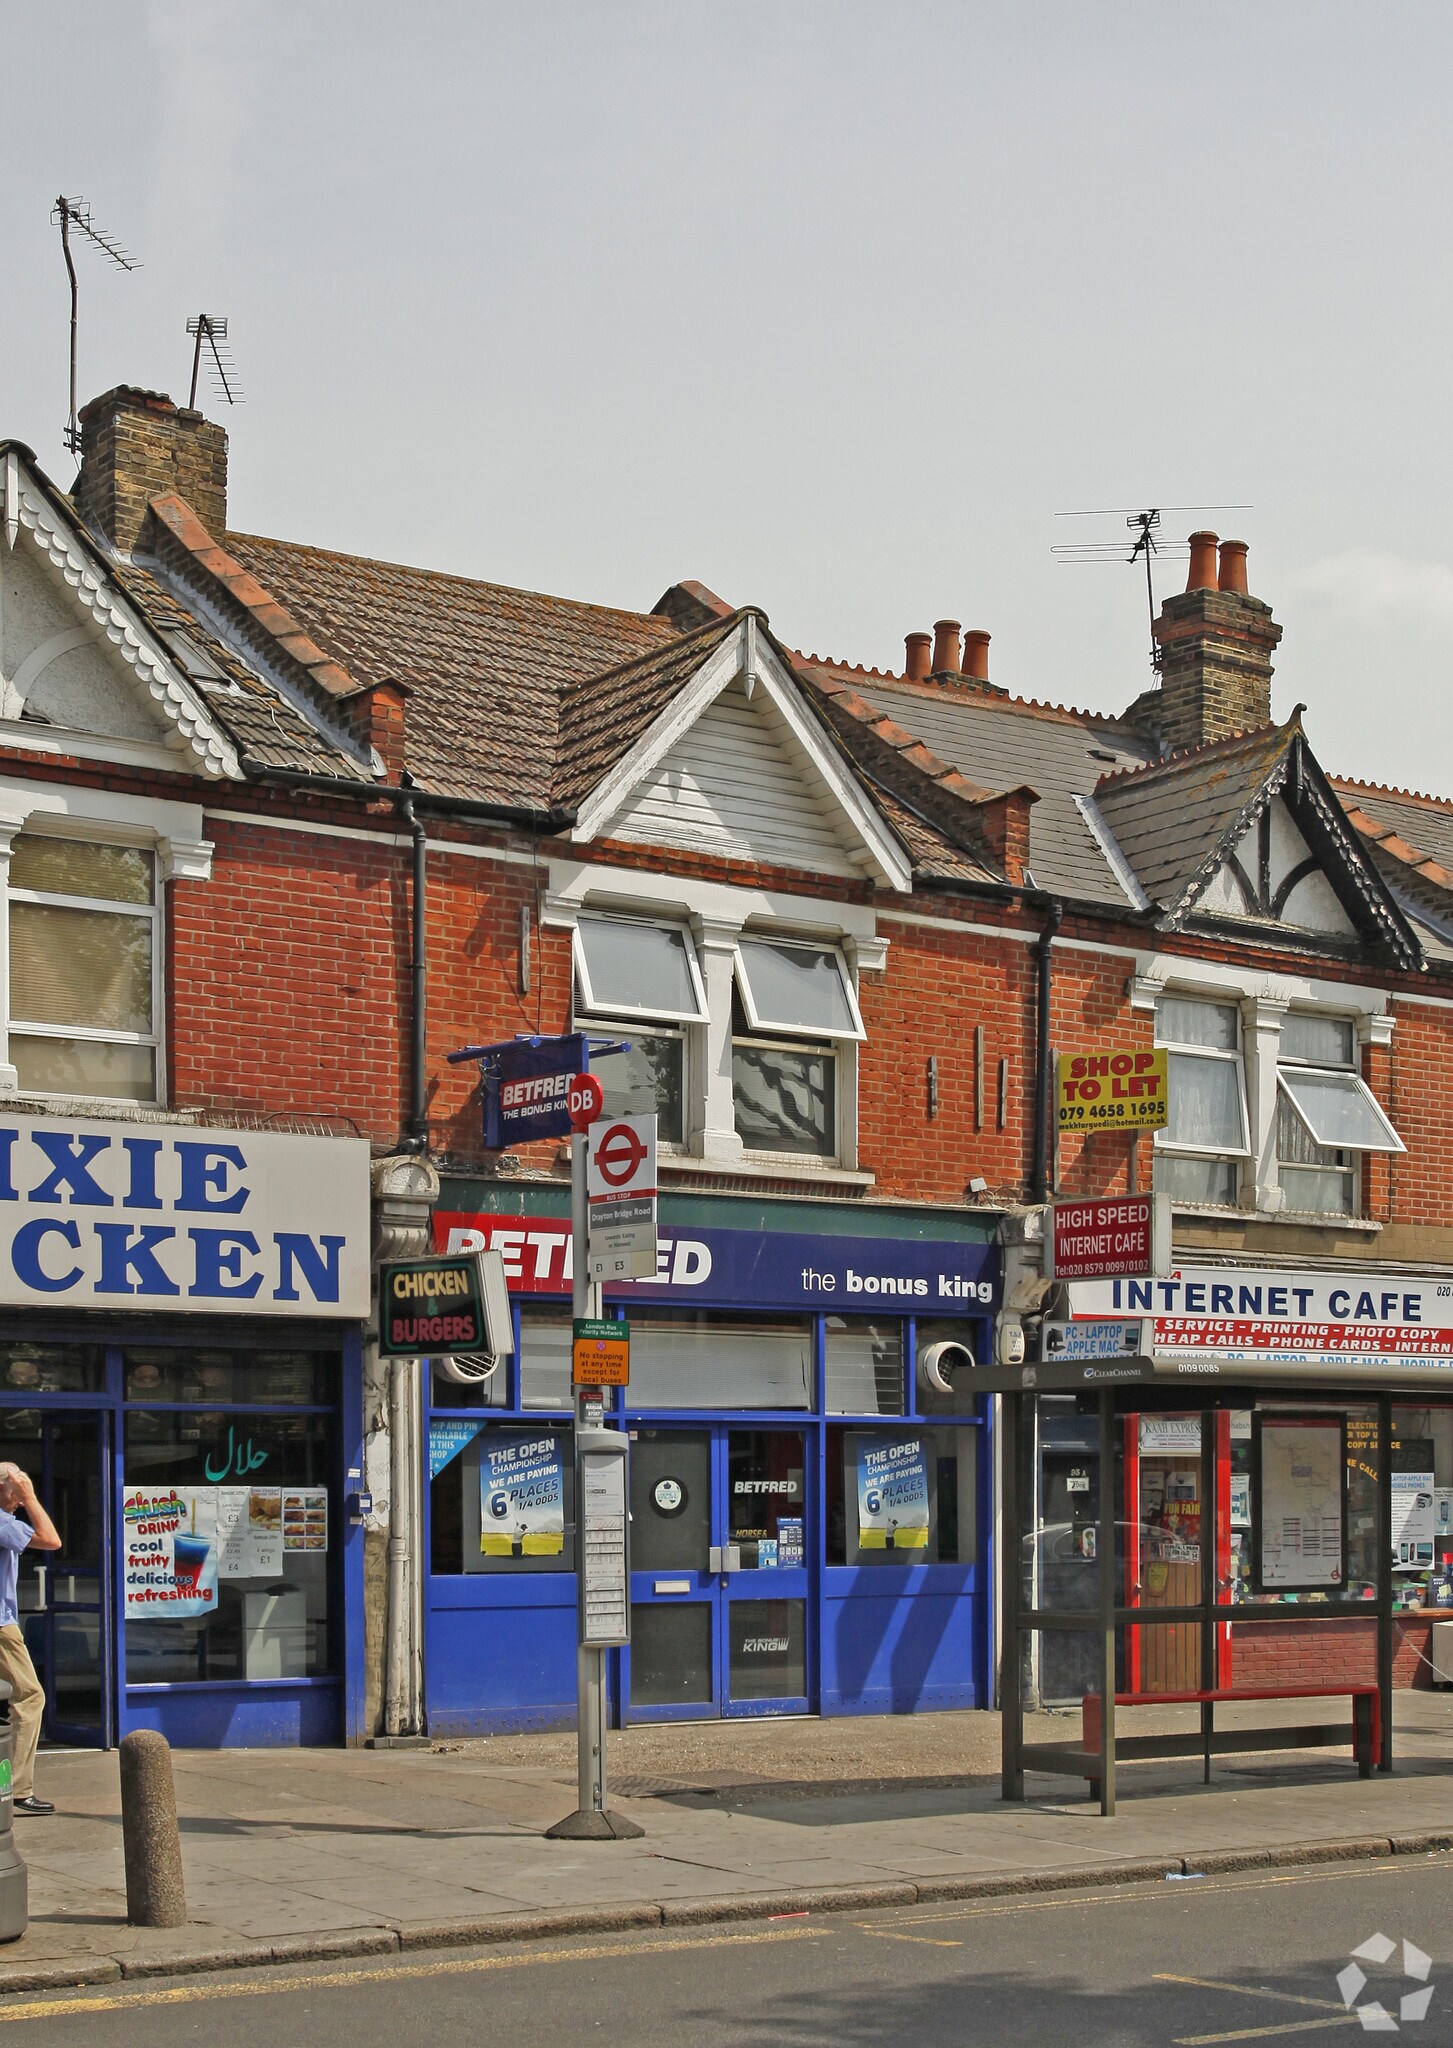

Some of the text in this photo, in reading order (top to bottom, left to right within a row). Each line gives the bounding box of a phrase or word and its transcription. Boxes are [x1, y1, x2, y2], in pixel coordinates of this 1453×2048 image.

[1070, 1053, 1154, 1078] SHOP
[1063, 1075, 1161, 1101] TO LET
[503, 1100, 569, 1120] THE BONUS KIN
[571, 1089, 594, 1113] DB
[1060, 1101, 1165, 1120] 079 4658 1695
[592, 1207, 651, 1222] Drayton Bridge Road
[1056, 1205, 1149, 1229] HIGH SPEED
[1060, 1234, 1112, 1257] INTERNET
[446, 1227, 712, 1286] BETED
[596, 1261, 624, 1272] E1 E3
[1055, 1260, 1148, 1276] Tel:020 8579 0099/0102
[393, 1270, 468, 1299] CHICKEN
[801, 1267, 993, 1303] the bonus king
[1437, 1286, 1450, 1297] 020
[1112, 1279, 1422, 1322] INTERNET CAFE
[392, 1316, 475, 1342] BURGERS
[1066, 1325, 1122, 1338] PC LAPTOP
[1164, 1320, 1234, 1332] SERVICE
[1251, 1323, 1329, 1335] PRINTING
[1344, 1327, 1396, 1339] PHOTO
[1400, 1329, 1440, 1340] COPY
[1067, 1340, 1119, 1353] APPLE MAC
[1206, 1335, 1254, 1346] CALLS
[1269, 1337, 1324, 1349] PHONE
[1329, 1339, 1381, 1350] CARDS
[1395, 1342, 1453, 1353] INTERN
[593, 1353, 623, 1361] stopping
[464, 1422, 477, 1430] PIN
[1145, 1422, 1169, 1434] KAAH
[205, 1425, 269, 1482] حلال
[437, 1441, 454, 1449] THIS
[488, 1448, 516, 1465] THE
[519, 1438, 555, 1458] OPEN
[865, 1450, 887, 1466] THE
[889, 1441, 920, 1458] OPEN
[492, 1454, 552, 1475] CHAMPIONSHIP
[867, 1455, 918, 1475] CHAMPIONSHIP
[489, 1465, 558, 1489] WE ARE PAYING
[865, 1465, 923, 1488] WE ARE PAYING
[734, 1481, 797, 1494] BETFRED
[867, 1478, 924, 1514] 6 PLACES
[491, 1492, 507, 1517] 6
[510, 1478, 560, 1502] PLACES
[519, 1492, 559, 1510] 1/4 ODDS
[890, 1491, 924, 1507] 1/4 ODDS
[1165, 1503, 1201, 1515] FUN FAIR
[137, 1520, 180, 1536] DRINK
[228, 1515, 239, 1523] £3
[736, 1529, 761, 1538] HORSE
[129, 1539, 163, 1552] cool
[759, 1544, 777, 1552] 21?
[128, 1555, 170, 1568] fruity
[127, 1572, 193, 1585] delicious
[128, 1587, 213, 1603] refreshing
[743, 1642, 778, 1652] KING
